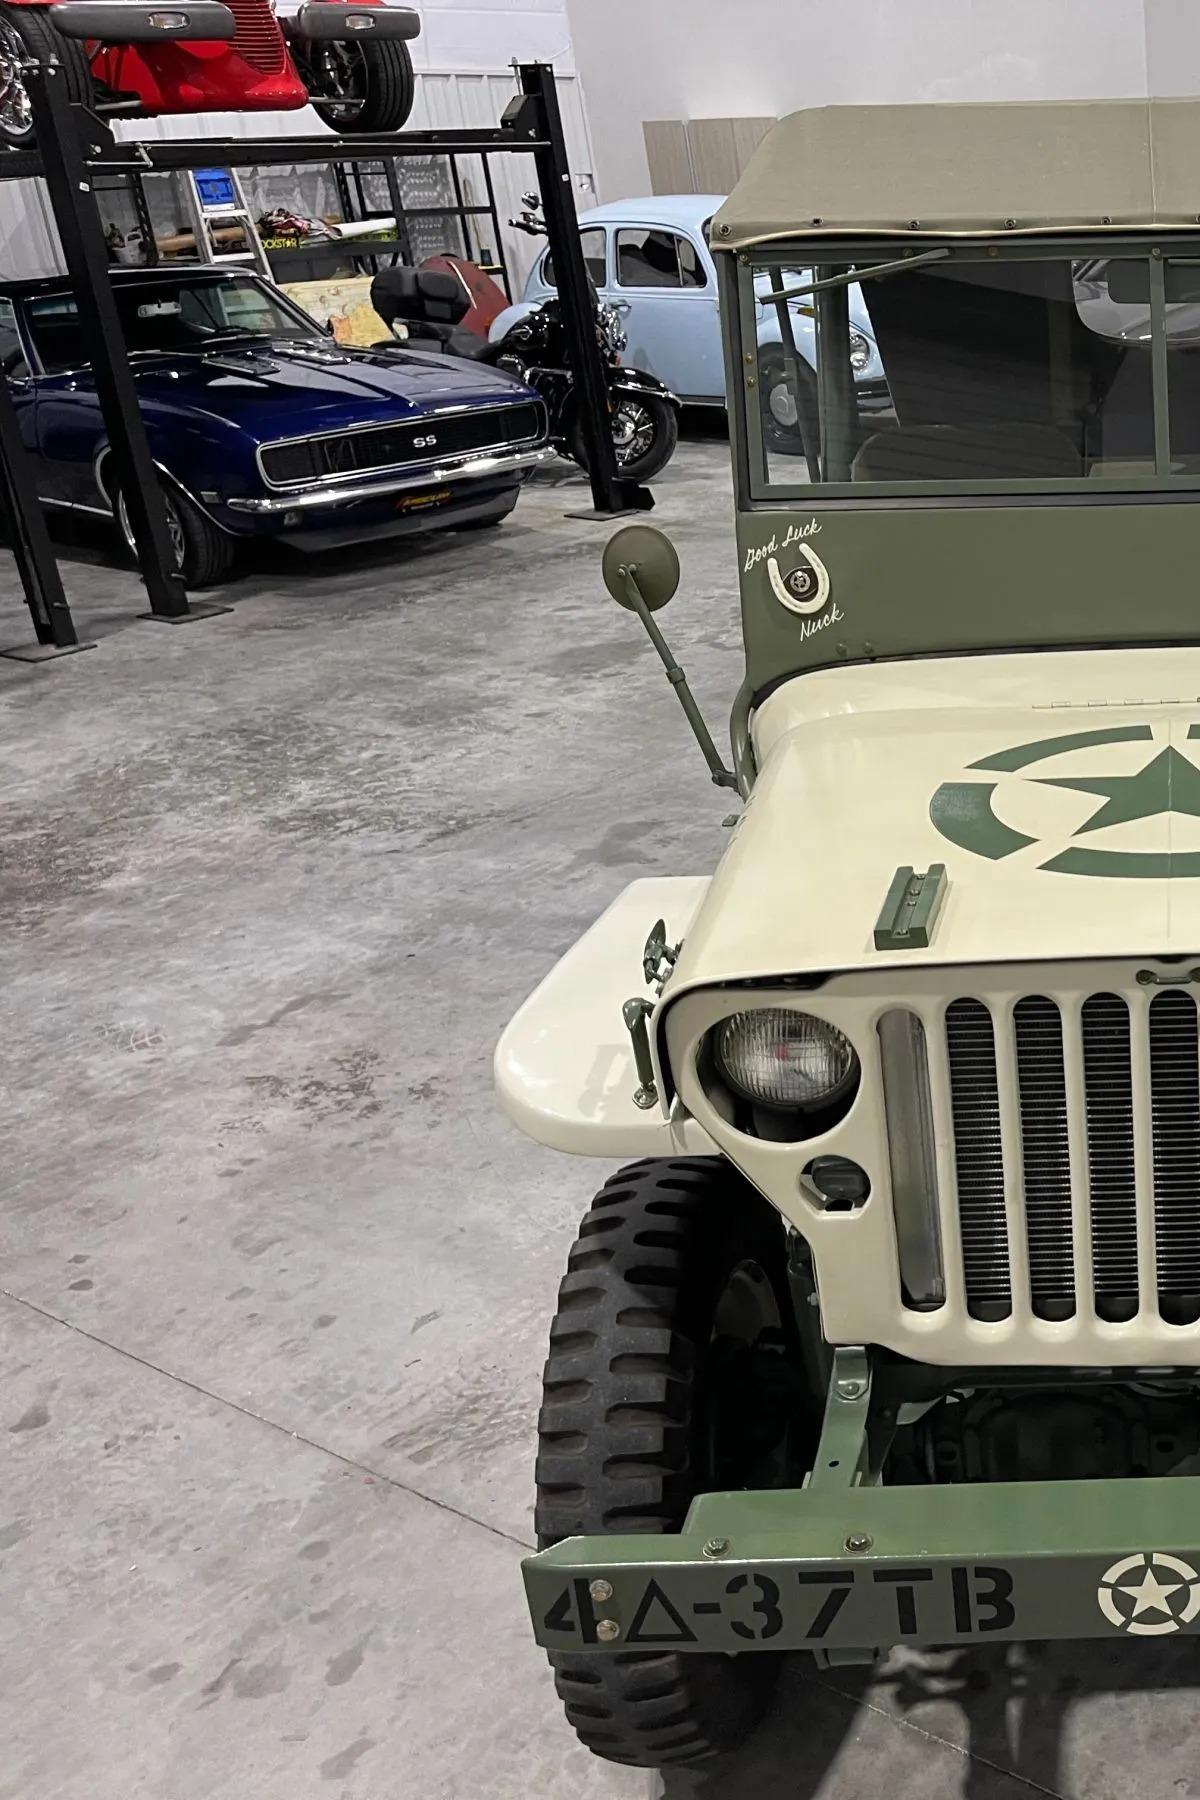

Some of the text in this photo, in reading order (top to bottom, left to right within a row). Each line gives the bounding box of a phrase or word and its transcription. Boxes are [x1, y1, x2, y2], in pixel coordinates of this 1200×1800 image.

[413, 434, 437, 448] SS
[744, 517, 822, 573] Good Luck
[800, 602, 845, 642] Nuck
